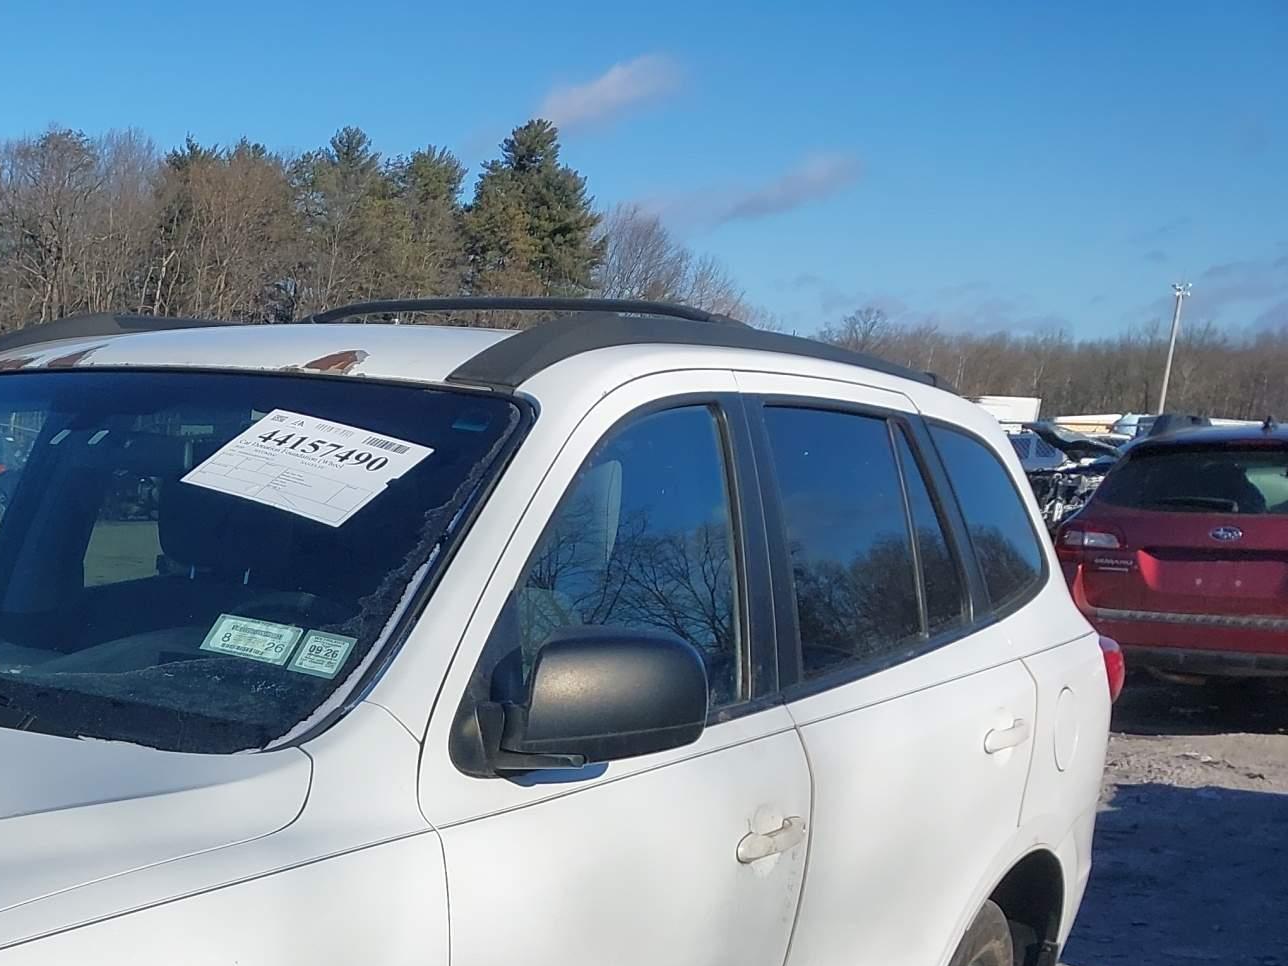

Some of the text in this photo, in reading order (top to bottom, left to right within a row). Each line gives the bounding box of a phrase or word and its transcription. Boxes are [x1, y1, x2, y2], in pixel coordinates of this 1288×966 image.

[258, 429, 389, 472] 44157490
[221, 632, 232, 643] 8
[265, 642, 285, 654] 26
